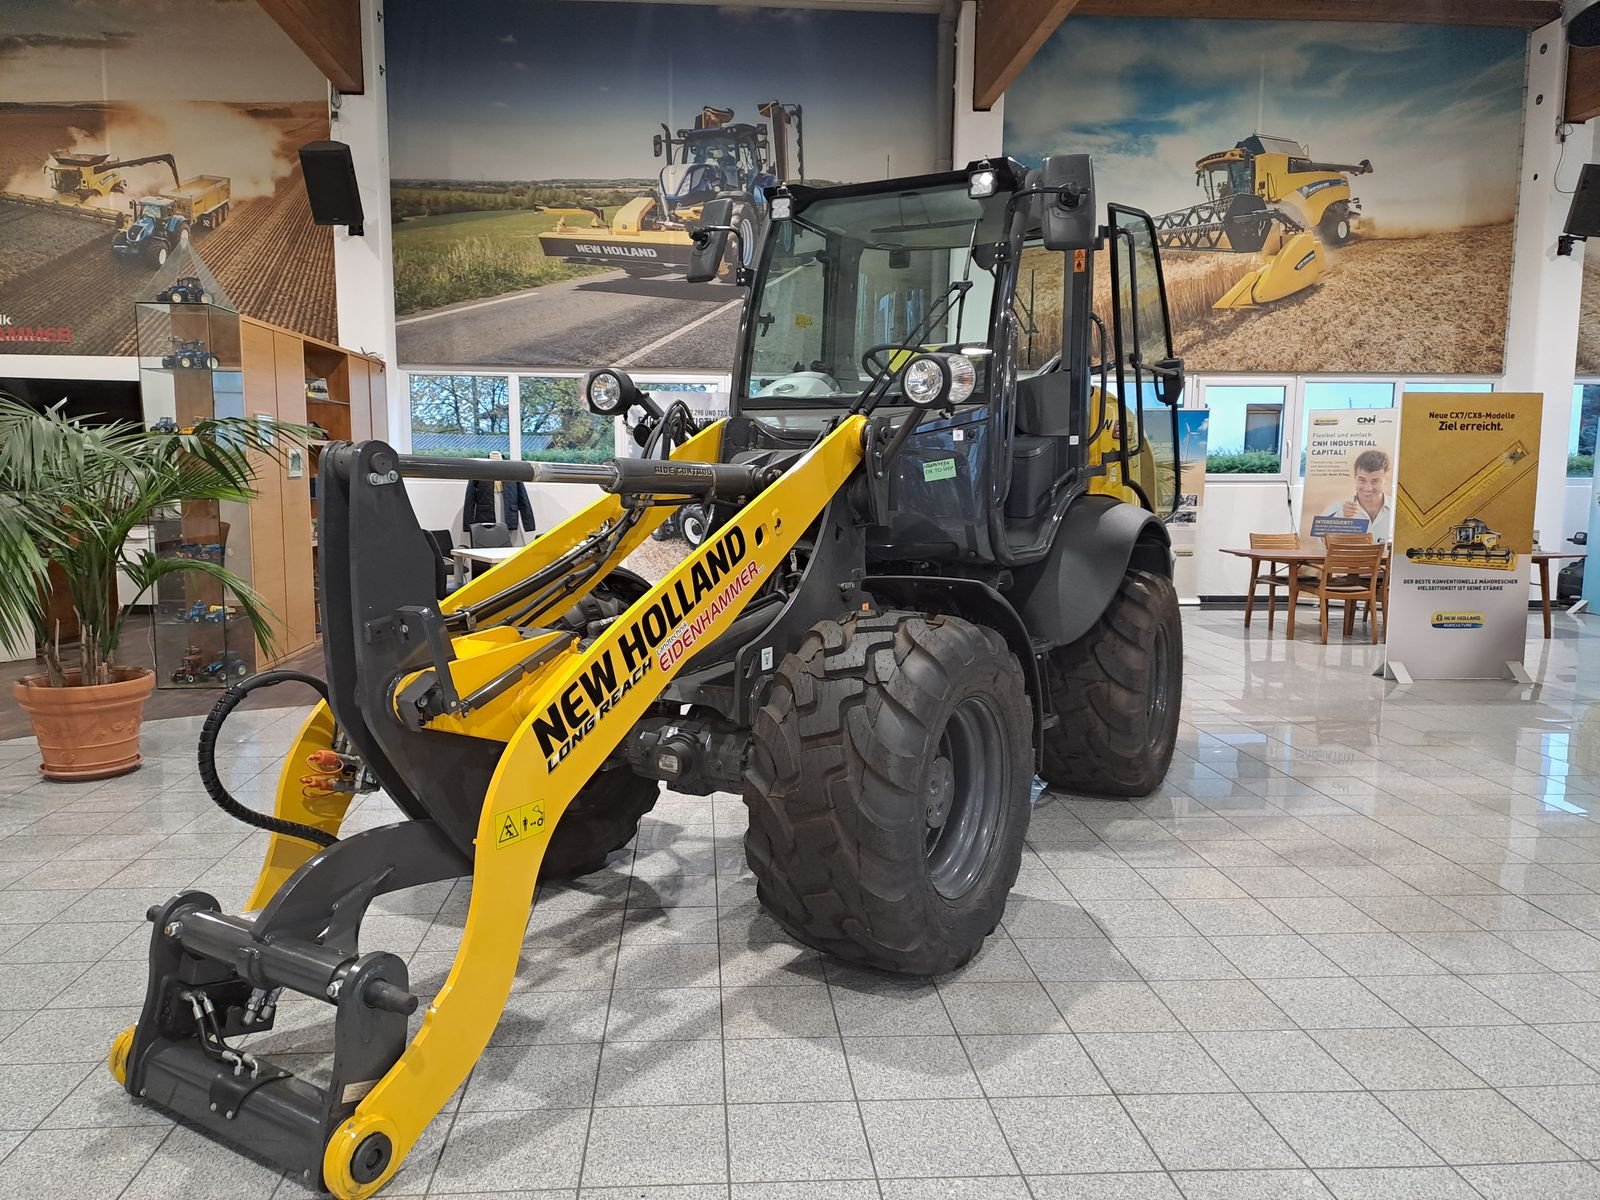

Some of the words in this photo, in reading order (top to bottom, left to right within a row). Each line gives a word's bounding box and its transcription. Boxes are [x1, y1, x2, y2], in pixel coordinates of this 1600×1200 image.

[575, 244, 601, 254] NEW
[601, 245, 657, 258] HOLLAND
[1450, 412, 1515, 420] CX7/CX8-Modelle
[1438, 421, 1457, 431] Ziel
[1459, 421, 1504, 431] erreicht.
[655, 466, 675, 475] RIDE
[659, 560, 759, 673] EIDENHAMMER
[531, 647, 618, 759] NEW
[617, 525, 747, 672] HOLLAND
[548, 713, 596, 775] LONG
[598, 656, 652, 719] REACH
